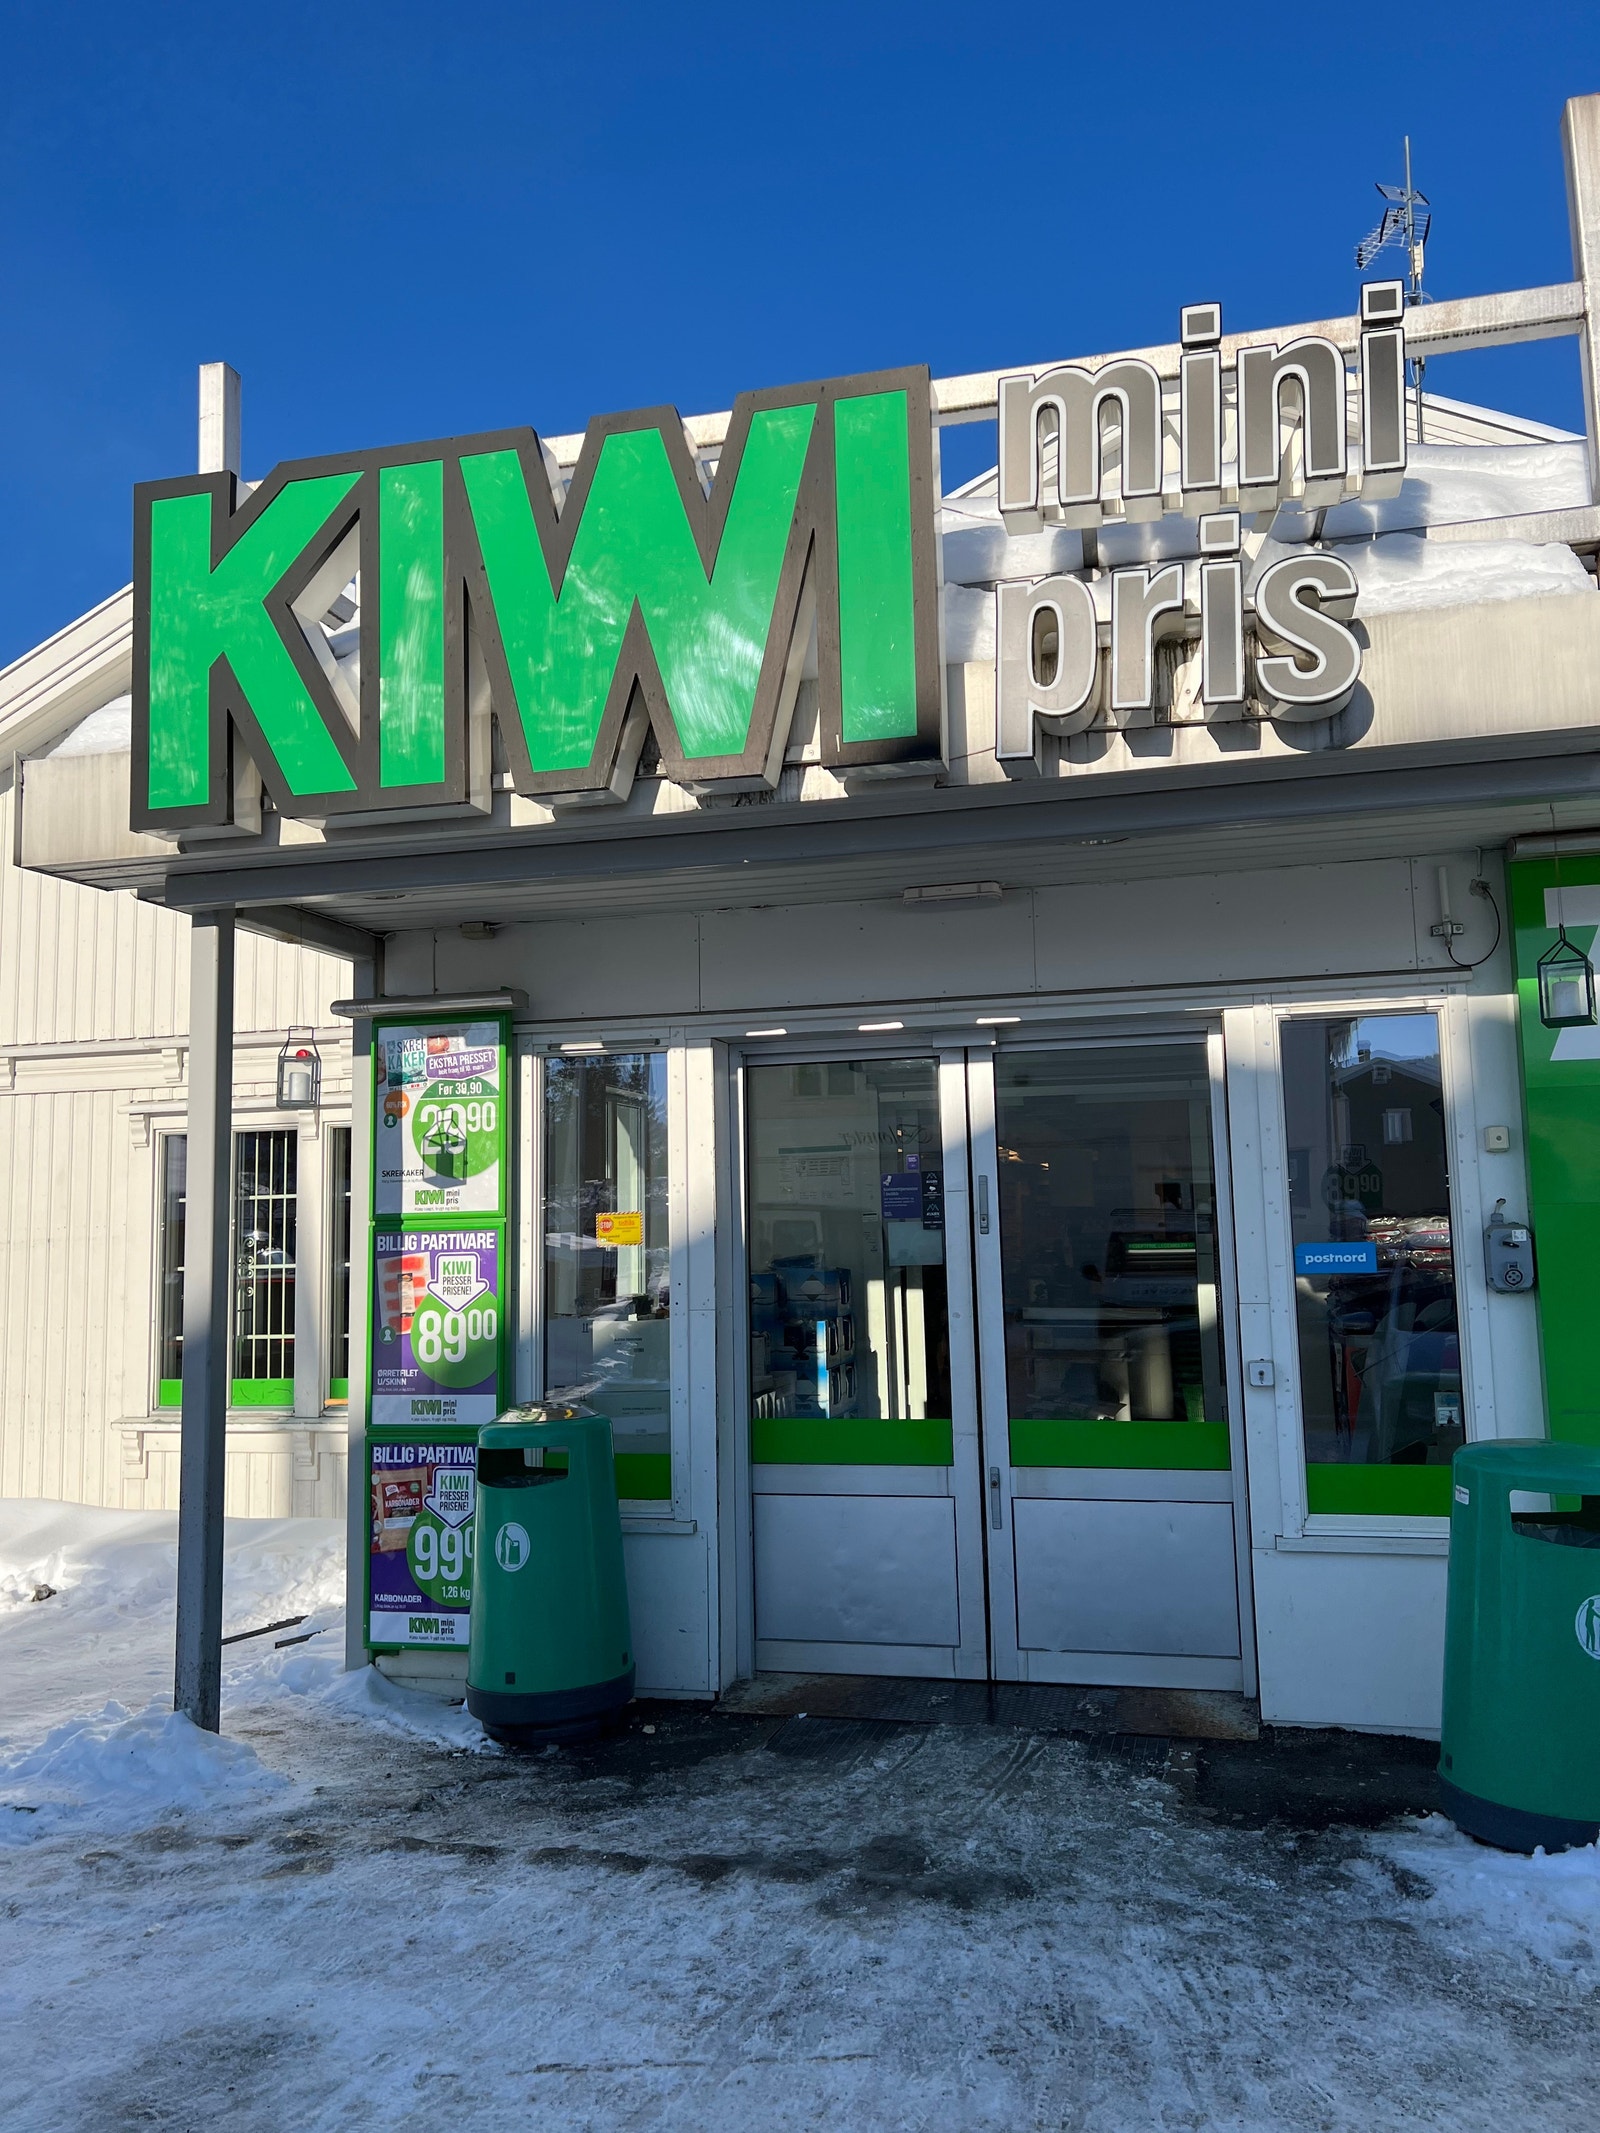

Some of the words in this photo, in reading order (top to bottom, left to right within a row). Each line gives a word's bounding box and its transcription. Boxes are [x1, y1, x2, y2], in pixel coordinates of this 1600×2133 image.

[998, 280, 1406, 512] mini
[133, 367, 940, 831] KIWI
[995, 512, 1362, 762] pris
[388, 1051, 426, 1070] KAKER
[429, 1056, 458, 1069] EKSTRA
[460, 1051, 493, 1065] PRESSET
[438, 1083, 454, 1095] Før
[415, 1189, 445, 1205] KIWI
[446, 1188, 460, 1197] mini
[446, 1196, 459, 1206] pris
[377, 1234, 417, 1252] BILLIG
[421, 1232, 496, 1250] PARTIVARE
[1305, 1253, 1367, 1265] postnord
[442, 1261, 472, 1275] KIWI
[442, 1276, 472, 1285] PRESSER
[442, 1286, 472, 1296] PRISENE!
[377, 1378, 407, 1386] U/SKINN
[411, 1399, 442, 1415] KIWI
[442, 1407, 456, 1416] pris
[373, 1446, 414, 1463] BILLIG
[418, 1446, 478, 1464] PARTIVA
[440, 1475, 469, 1490] KIWI
[440, 1491, 469, 1500] PRESSER
[440, 1502, 469, 1511] PRISENE!
[374, 1593, 422, 1603] KARBONADER
[441, 1586, 458, 1599] 1,26
[460, 1587, 471, 1600] kg
[409, 1617, 440, 1634] KIWI
[440, 1619, 455, 1627] mini
[440, 1626, 454, 1636] pris
